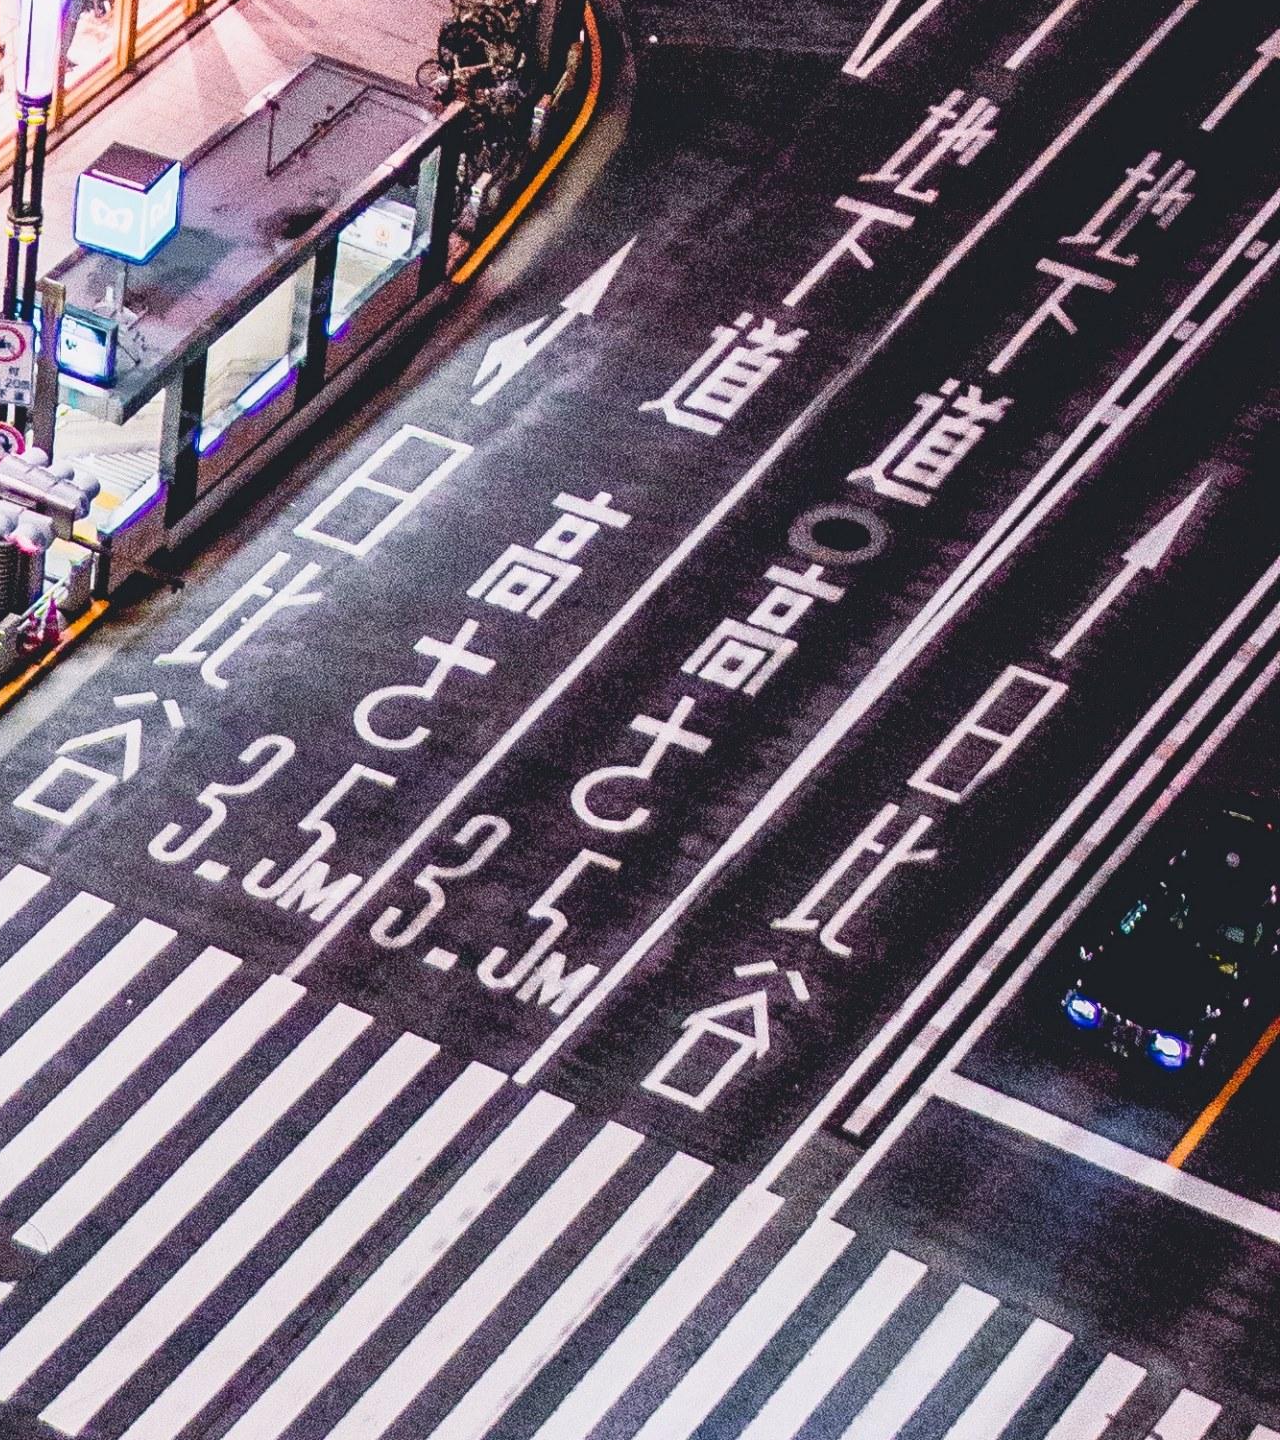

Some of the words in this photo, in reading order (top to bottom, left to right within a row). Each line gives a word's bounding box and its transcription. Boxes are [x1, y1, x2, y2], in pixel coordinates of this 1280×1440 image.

[639, 89, 996, 436] 地下道
[847, 152, 1195, 505] 地下道
[12, 424, 474, 826] 日比谷
[353, 490, 631, 751] 高さ
[571, 563, 844, 833] 高さ
[642, 664, 1069, 1112] 日比谷
